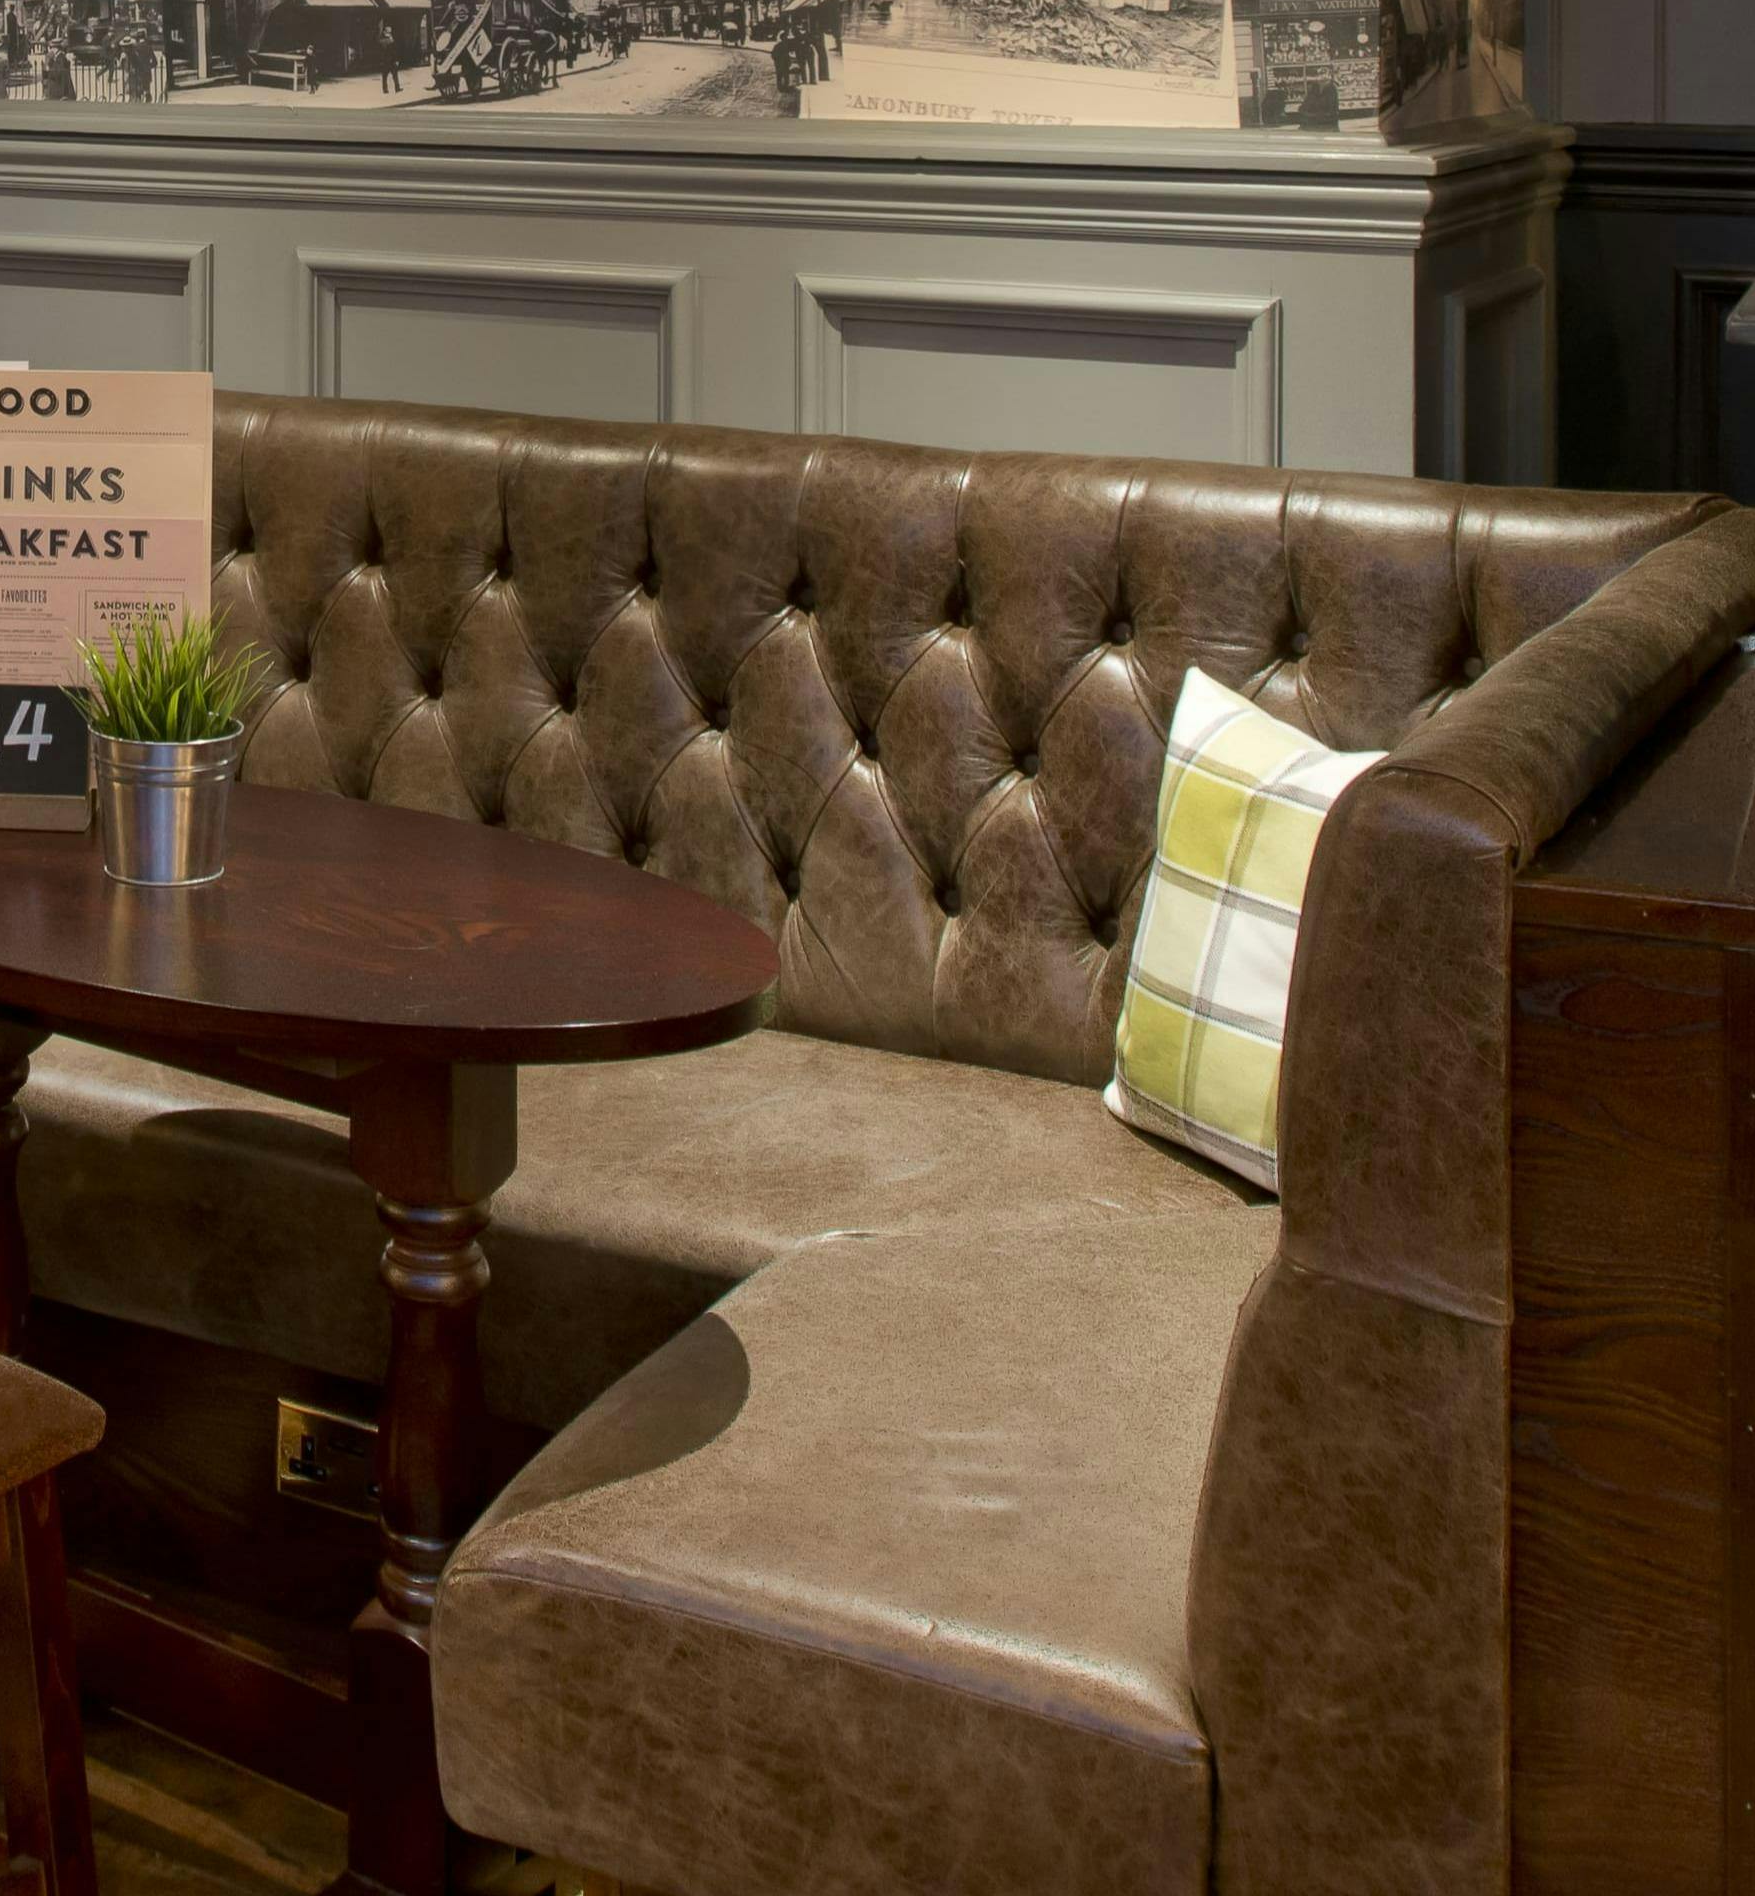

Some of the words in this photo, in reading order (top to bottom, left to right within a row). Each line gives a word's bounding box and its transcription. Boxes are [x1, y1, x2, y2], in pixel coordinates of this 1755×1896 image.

[0, 588, 48, 605] FAVOURITES
[93, 601, 150, 612] SANDWICH
[99, 611, 107, 620] A
[110, 611, 132, 621] HOT
